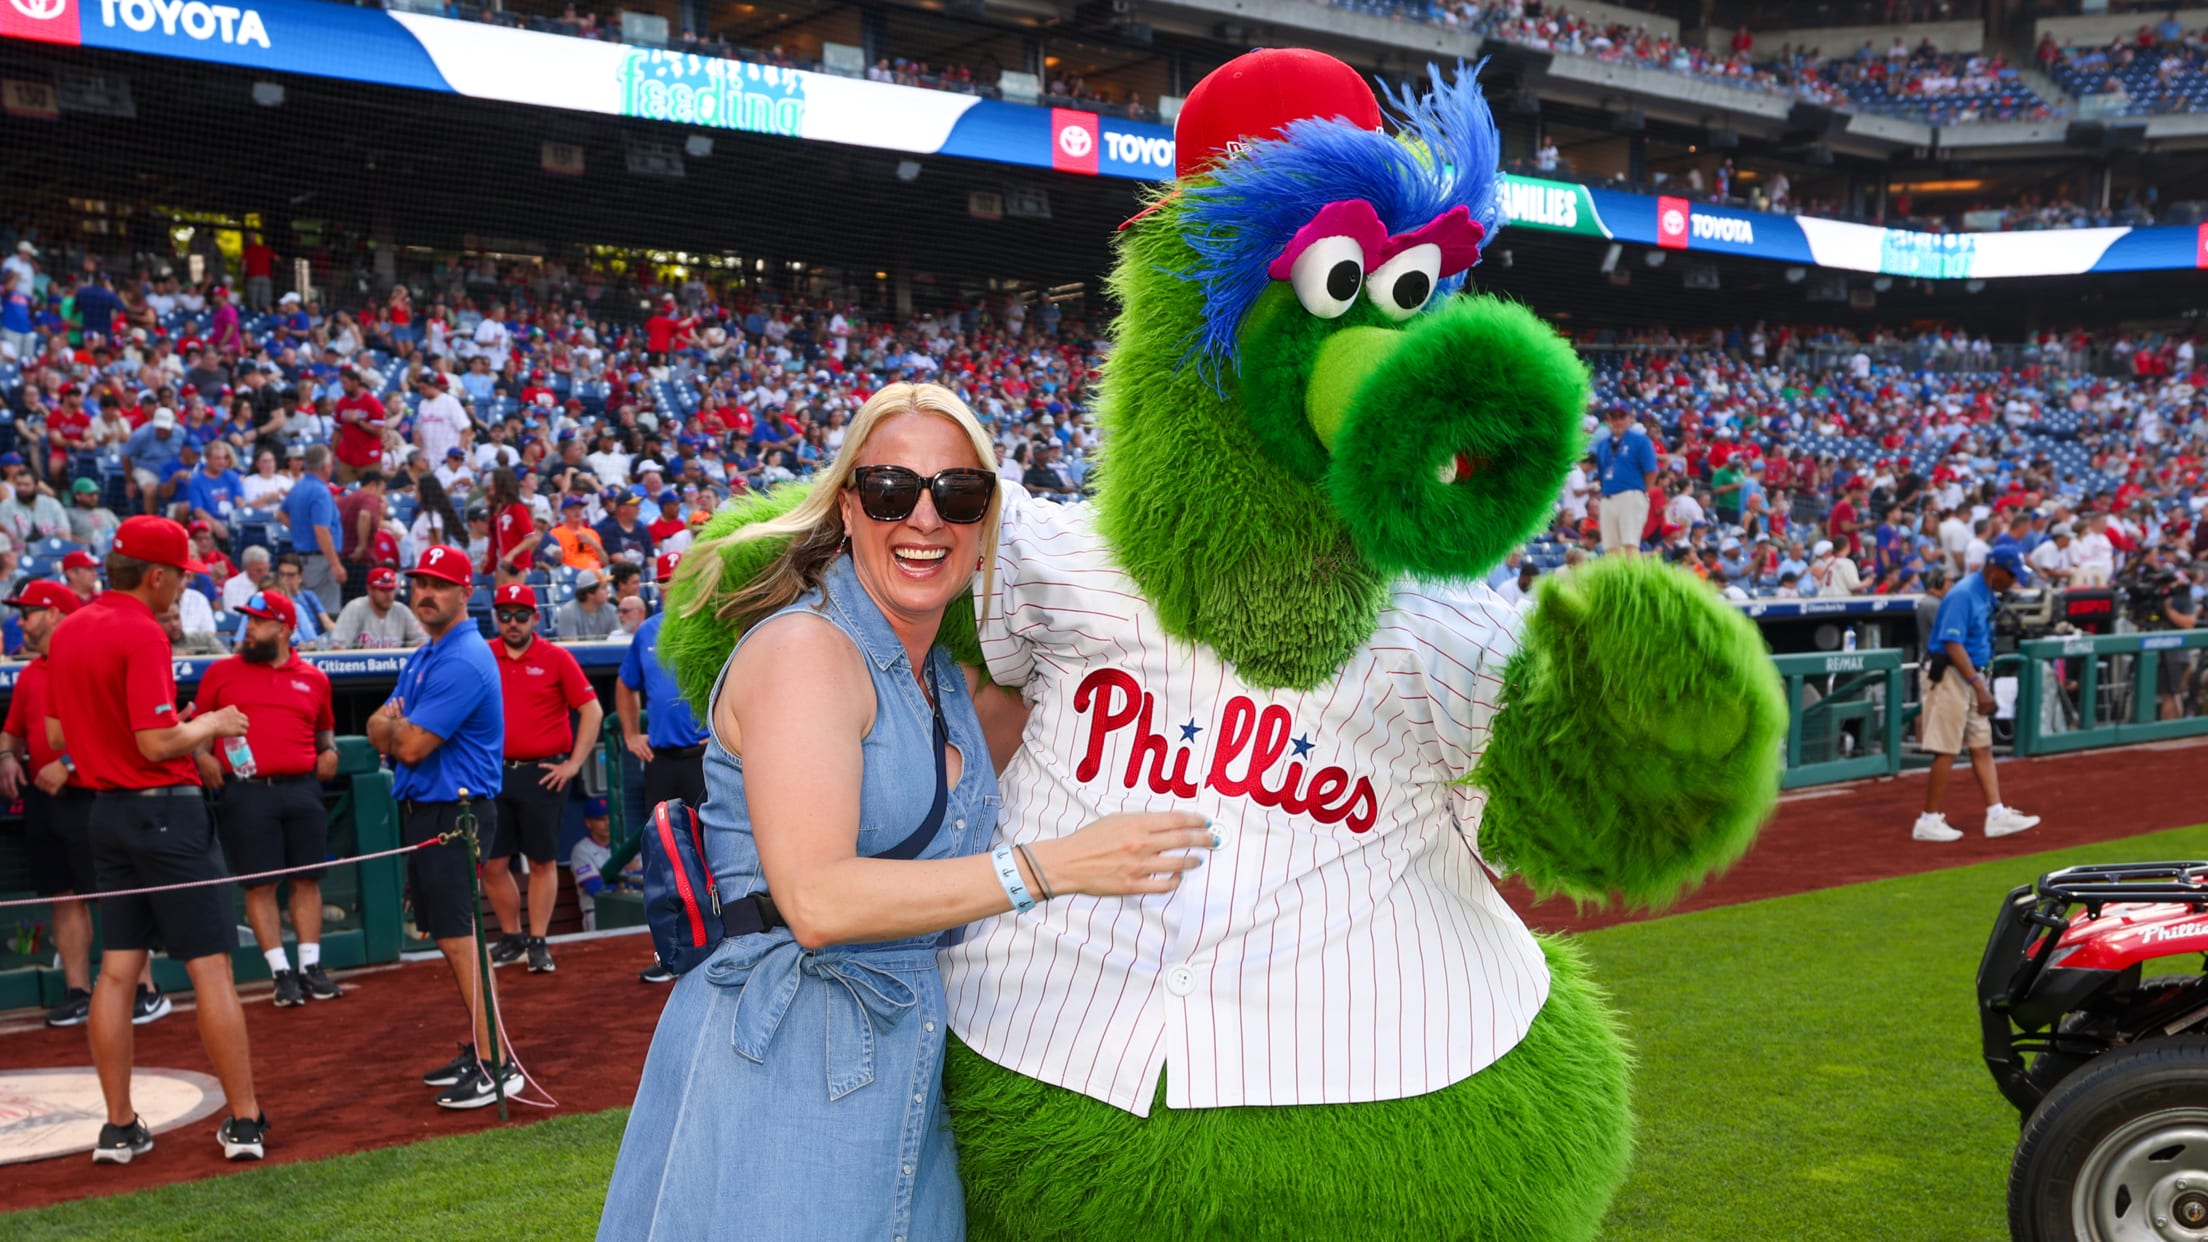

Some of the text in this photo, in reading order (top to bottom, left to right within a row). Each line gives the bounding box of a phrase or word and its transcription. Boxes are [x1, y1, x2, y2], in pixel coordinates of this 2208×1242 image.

[101, 0, 272, 48] TOYOTA
[1104, 131, 1175, 167] TOYO
[1498, 180, 1578, 228] AMILIES
[1690, 213, 1754, 245] TOYOTA
[429, 548, 445, 565] P
[508, 585, 521, 599] P
[317, 659, 366, 673] Citizens
[367, 658, 398, 672] Bank
[1826, 656, 1864, 672] RE/MAX
[1074, 668, 1378, 834] Phillies
